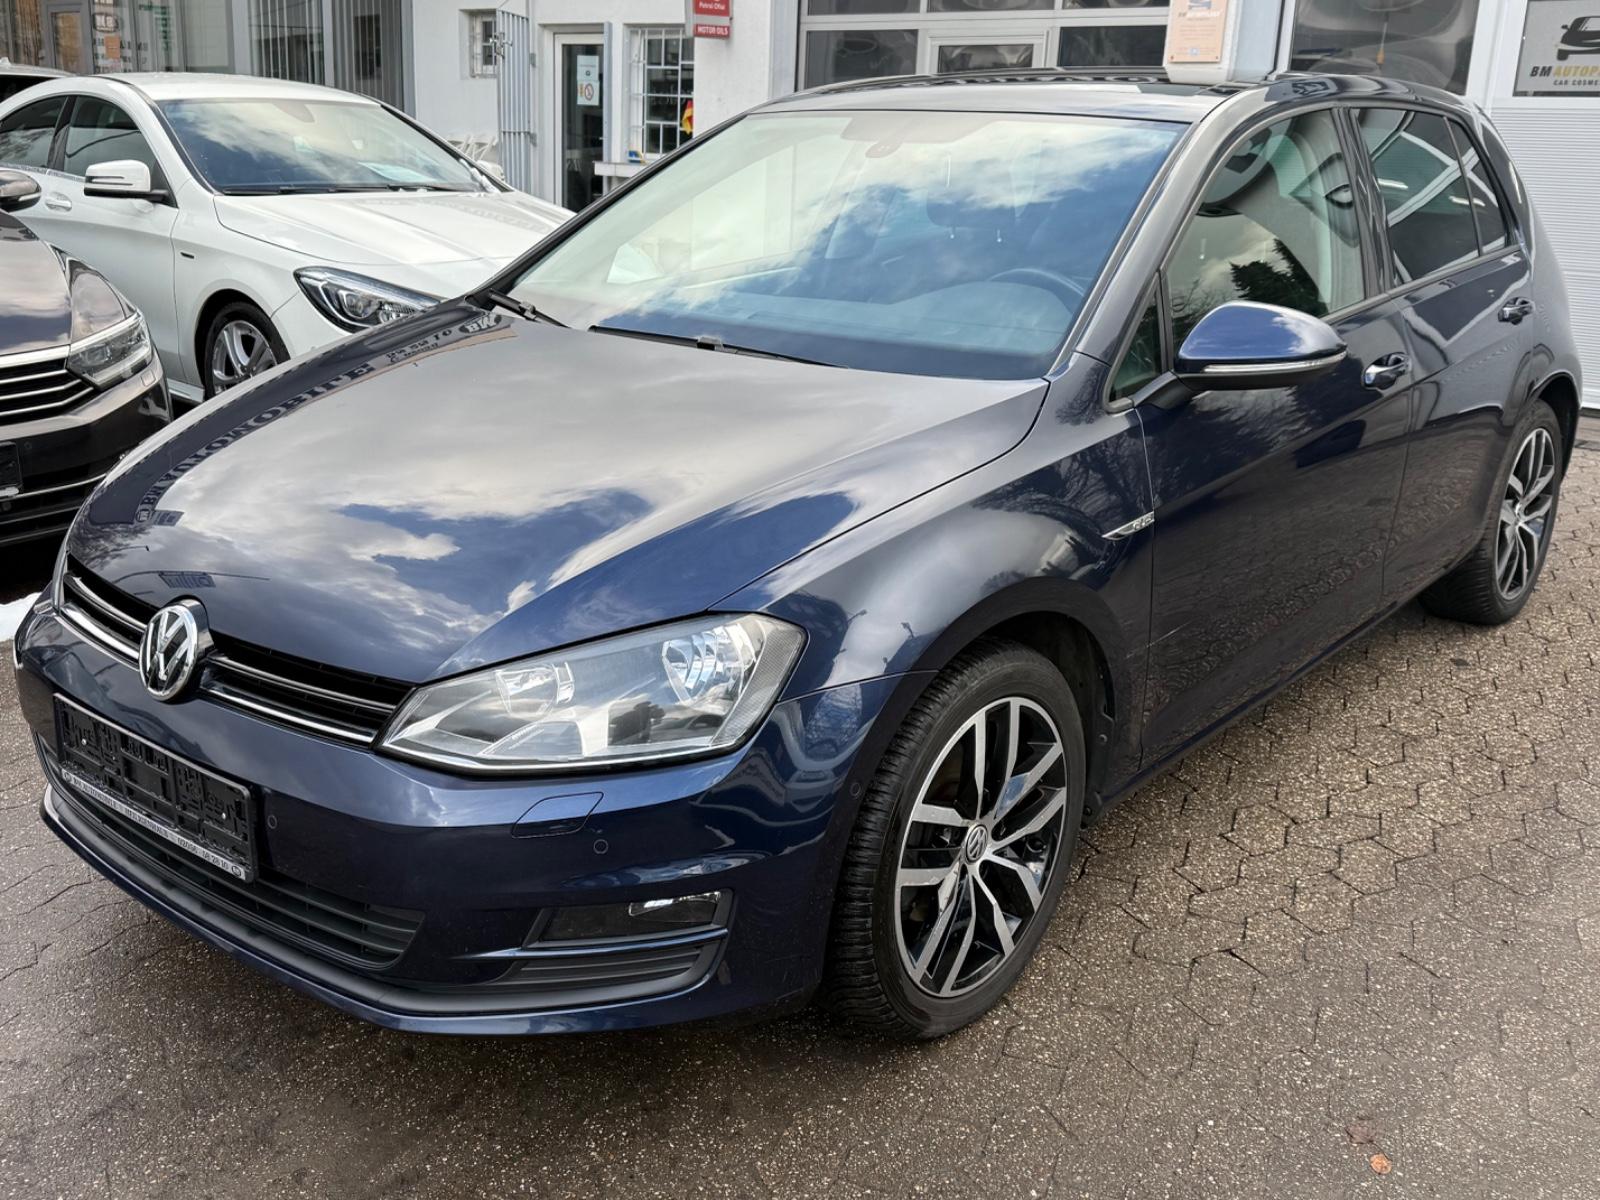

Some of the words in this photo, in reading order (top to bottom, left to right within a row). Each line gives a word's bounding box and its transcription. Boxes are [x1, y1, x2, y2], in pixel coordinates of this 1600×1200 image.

[697, 25, 716, 34] MOTOR
[716, 27, 729, 36] OILS
[1530, 66, 1552, 77] BM
[1553, 65, 1600, 77] AUTOP
